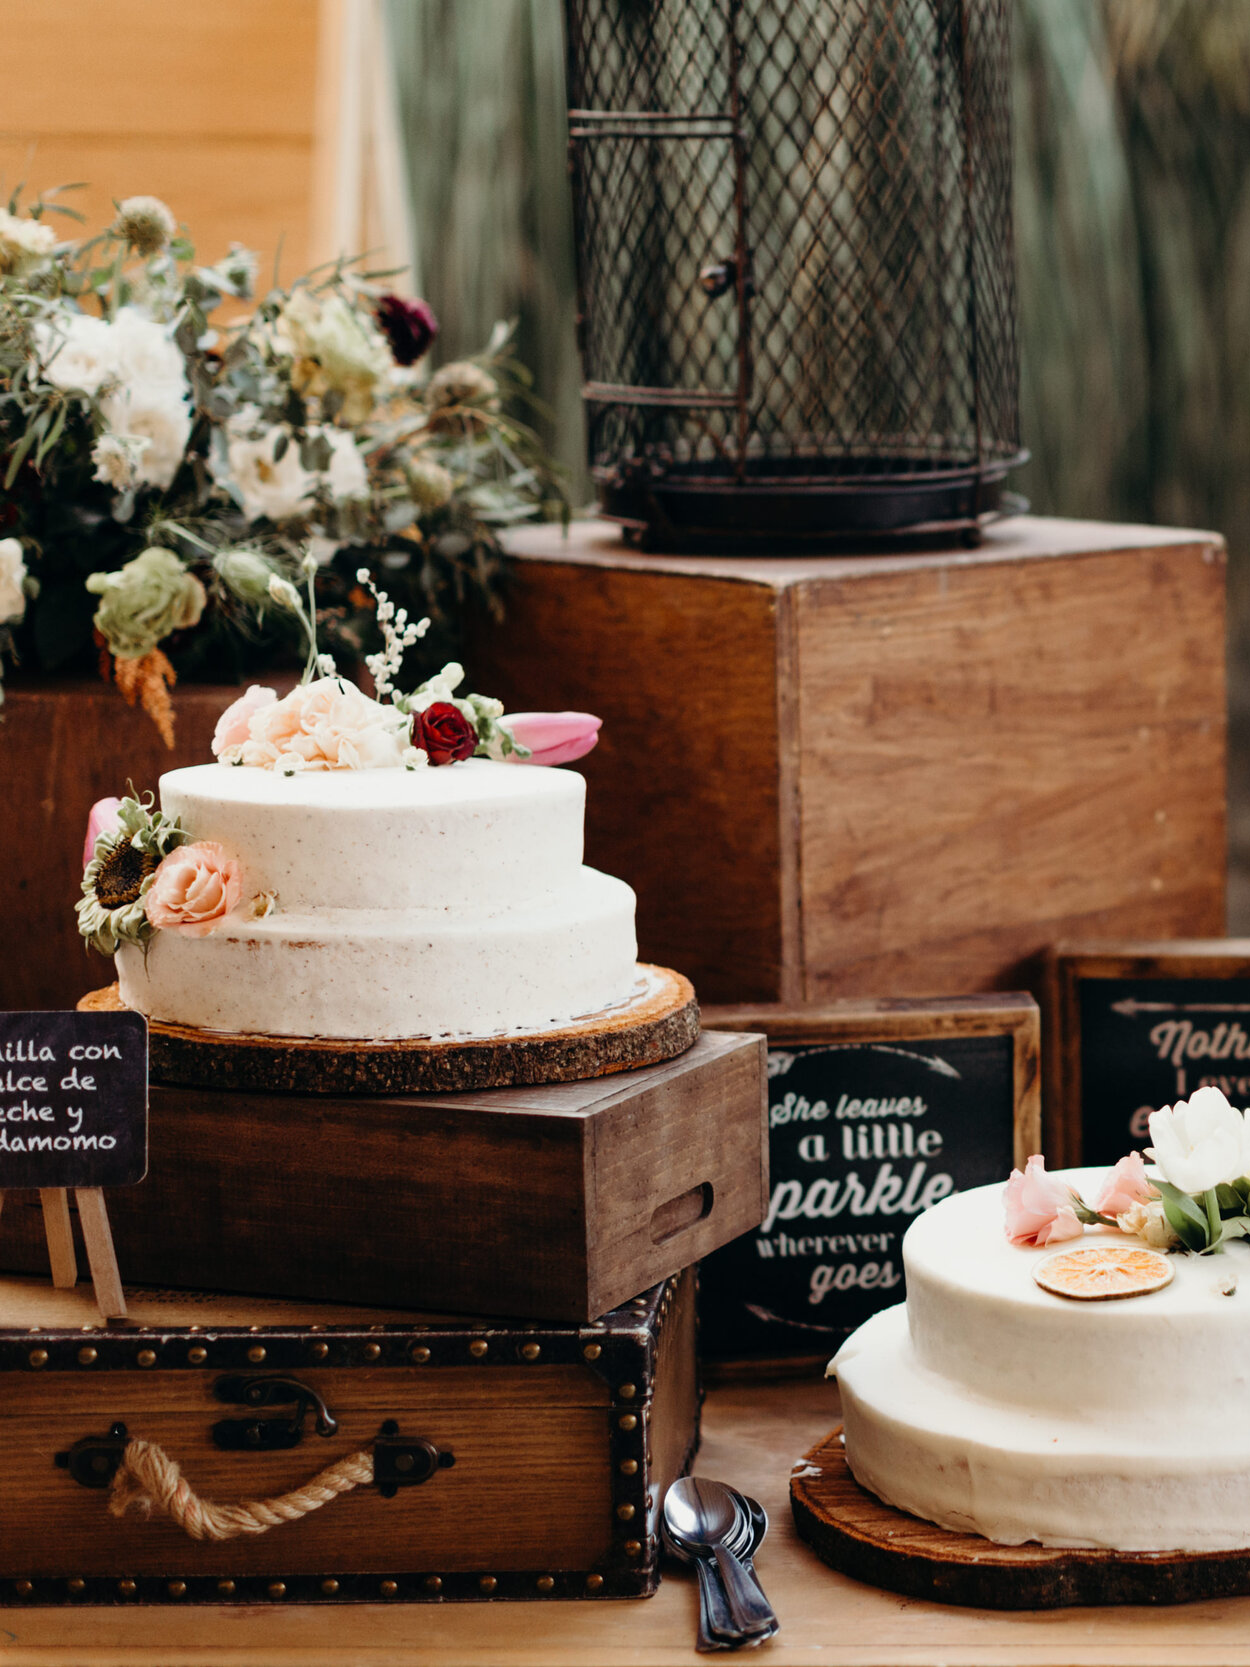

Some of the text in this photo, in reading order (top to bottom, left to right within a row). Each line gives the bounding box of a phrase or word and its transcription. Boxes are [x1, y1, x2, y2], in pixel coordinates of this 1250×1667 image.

[0, 1040, 122, 1062] illa con
[60, 1067, 97, 1091] de
[67, 1106, 83, 1133] y
[769, 1092, 928, 1128] She leaves
[0, 1128, 117, 1152] damomo
[798, 1122, 943, 1161] a little
[761, 1162, 958, 1233] parkle
[756, 1232, 895, 1258] wherever
[808, 1261, 901, 1304] goes
